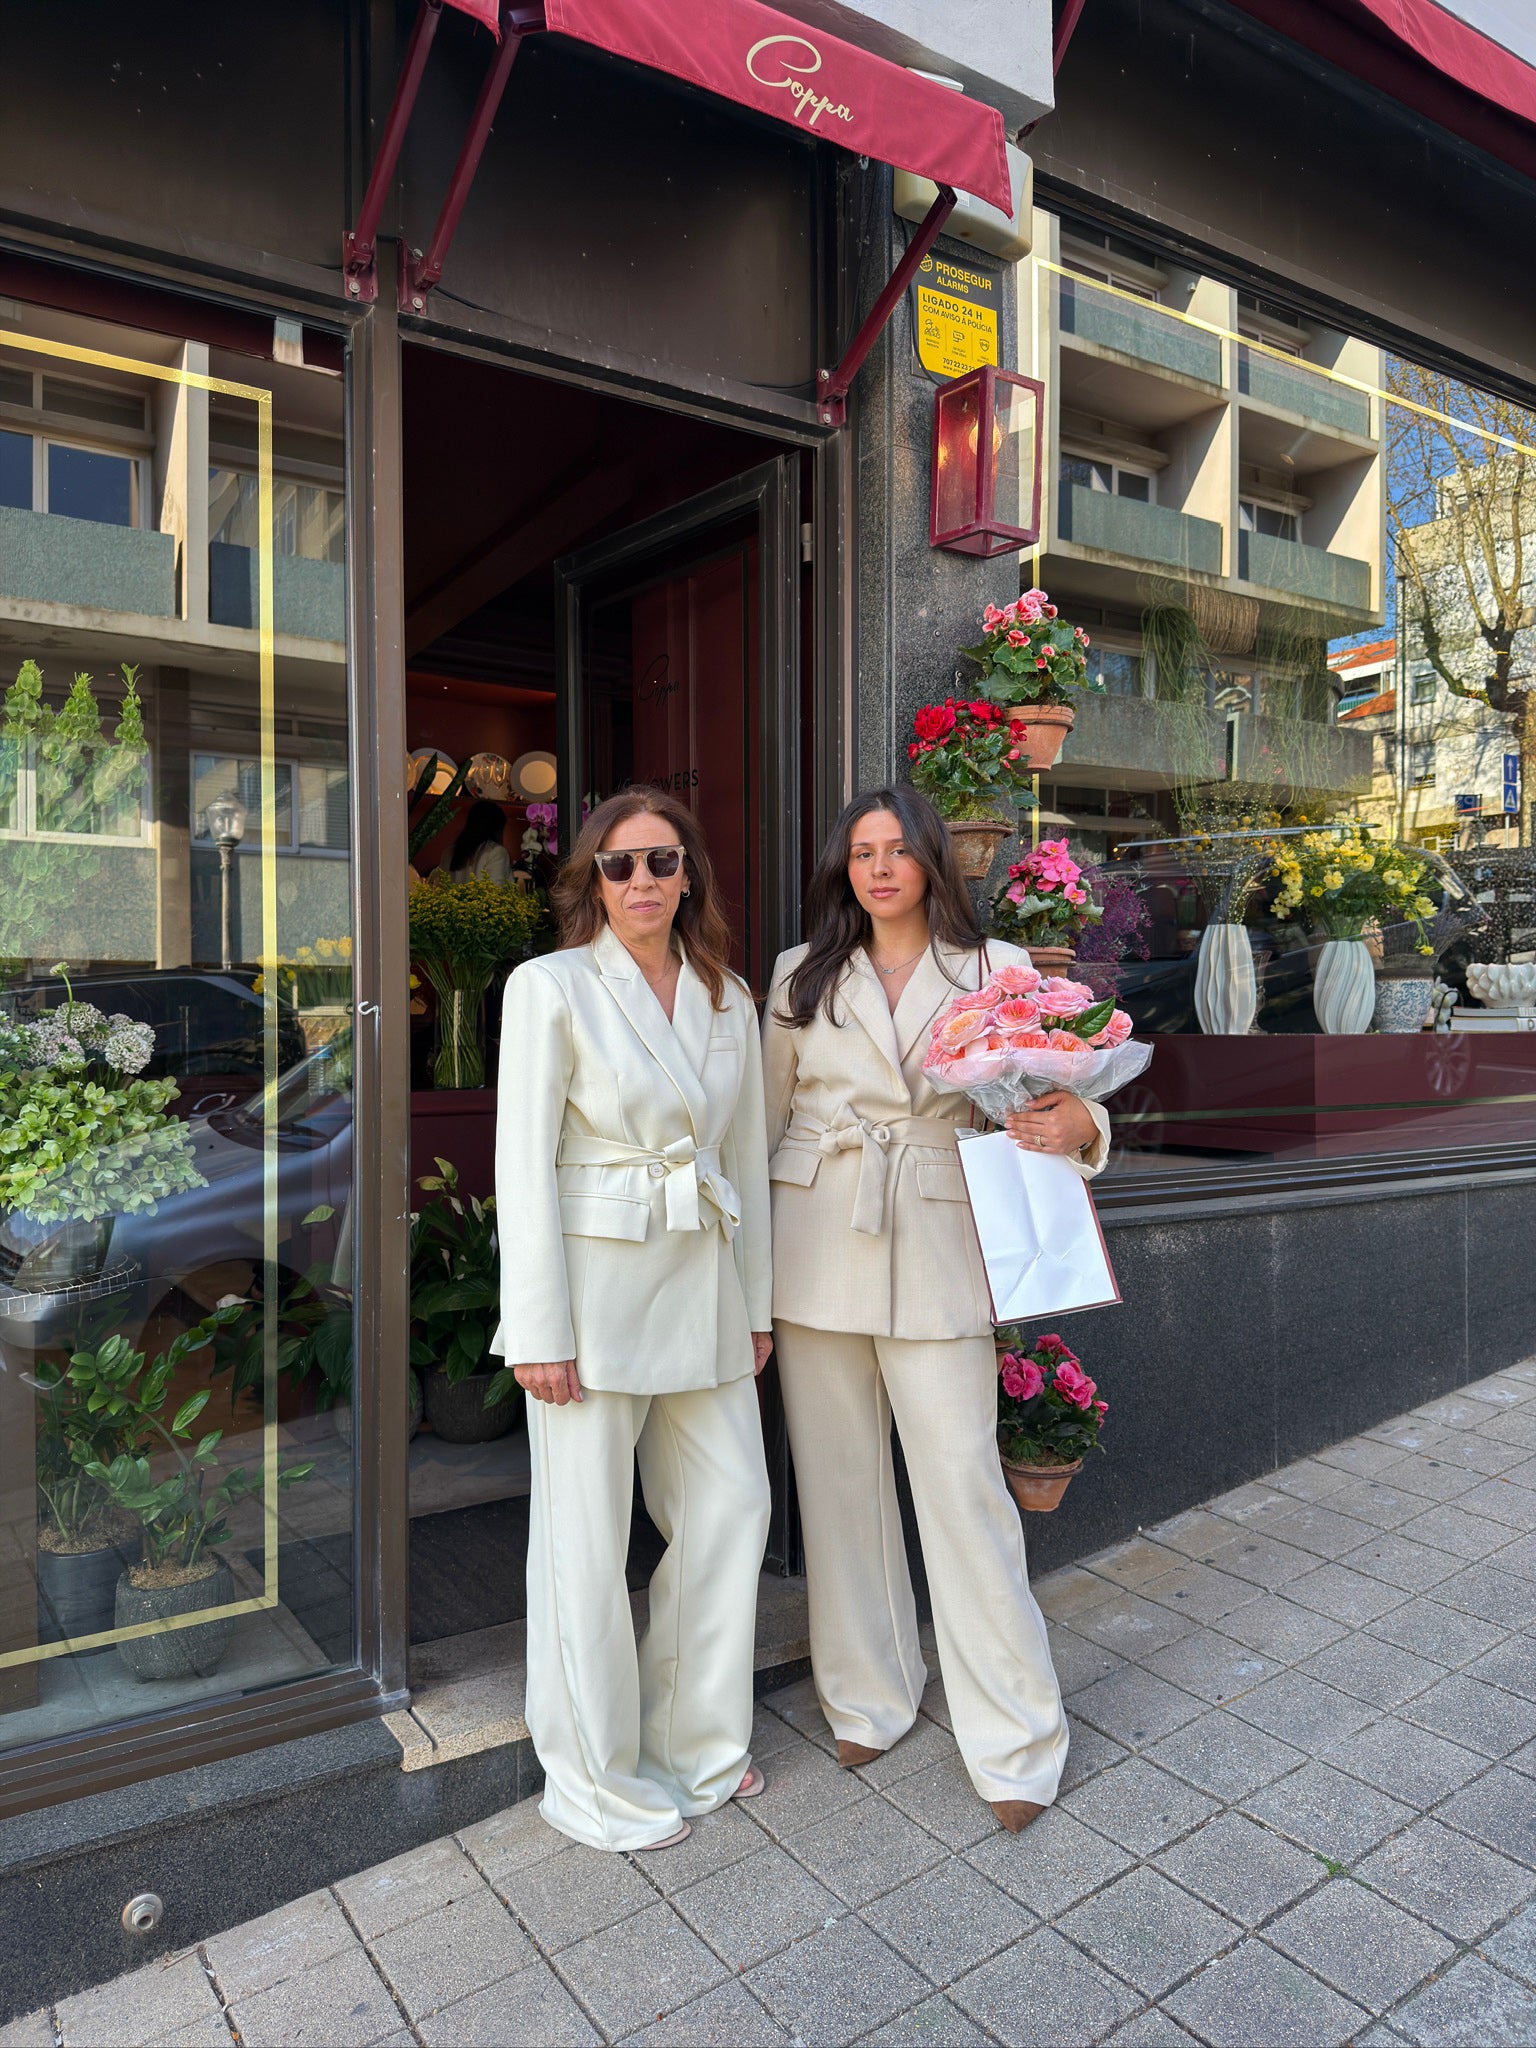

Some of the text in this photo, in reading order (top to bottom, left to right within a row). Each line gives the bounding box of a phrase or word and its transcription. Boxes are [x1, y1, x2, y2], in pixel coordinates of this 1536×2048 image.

[746, 35, 854, 125] Coppa
[936, 261, 992, 291] PROSEGUR
[936, 276, 969, 294] ALARMS
[922, 293, 983, 321] LIGADO 24 H
[922, 304, 940, 316] COM
[940, 311, 961, 324] AVISO
[967, 319, 992, 334] POLÍCIA
[942, 357, 953, 366] 707
[953, 360, 961, 369] 22
